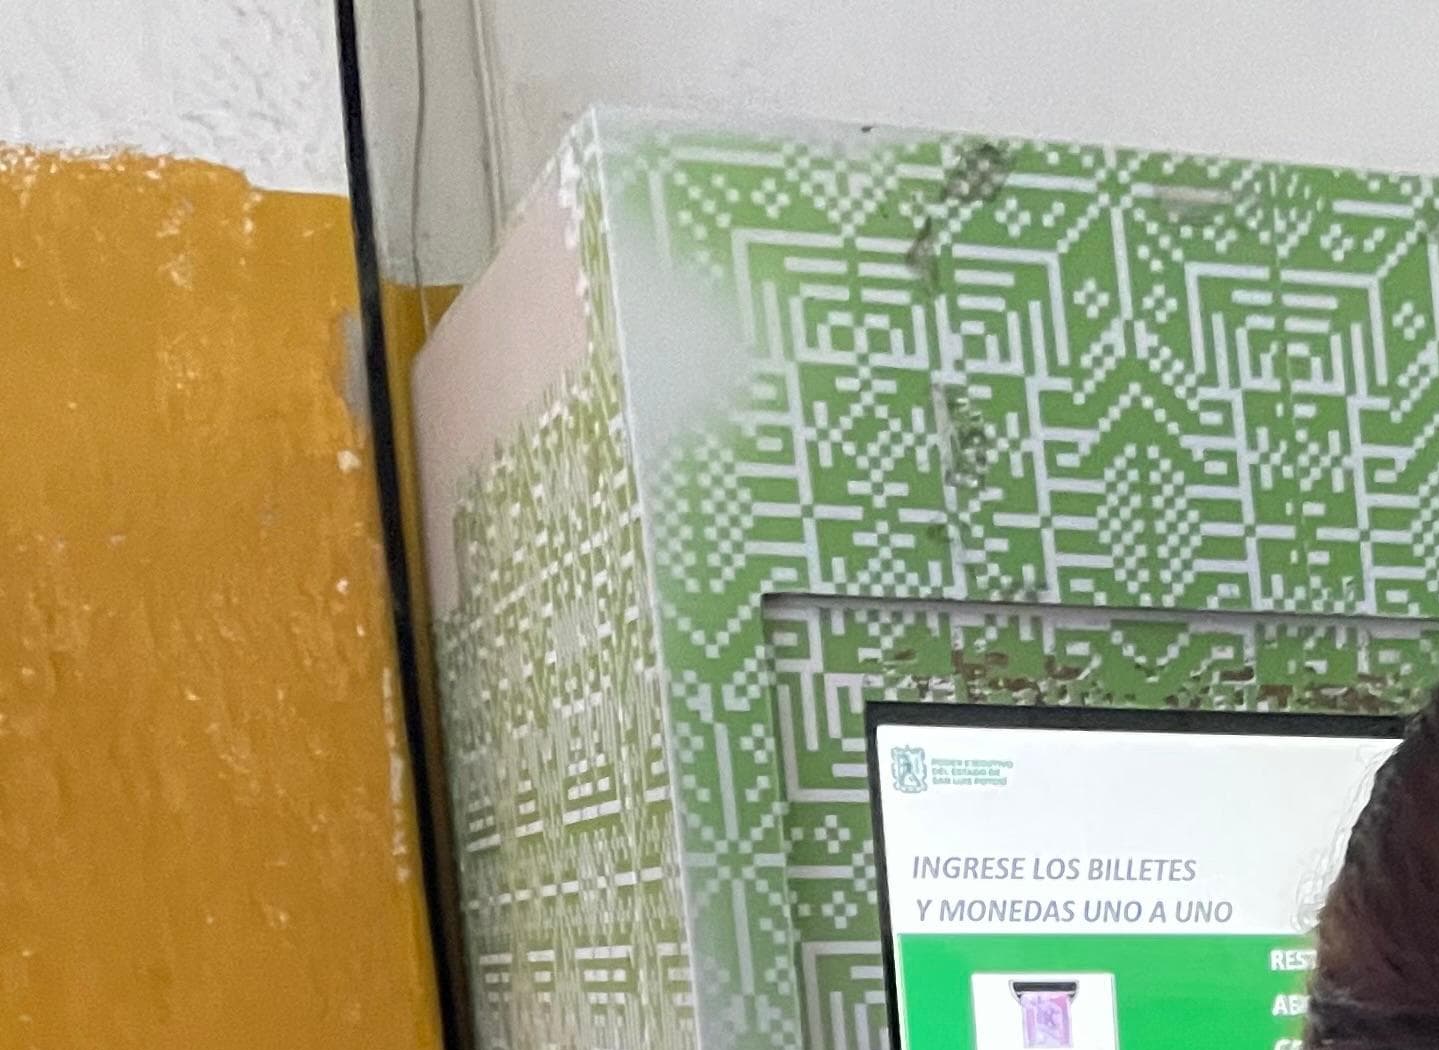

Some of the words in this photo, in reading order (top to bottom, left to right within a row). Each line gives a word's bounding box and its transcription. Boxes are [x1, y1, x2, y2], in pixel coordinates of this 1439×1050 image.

[912, 856, 1025, 880] INGRESE
[1032, 858, 1080, 880] LOS
[1087, 858, 1197, 882] BILLETES
[917, 899, 933, 921] Y
[939, 899, 1075, 922] MONEDAS
[1083, 899, 1142, 922] UNO
[1149, 900, 1166, 922] A
[1175, 900, 1233, 923] UNO
